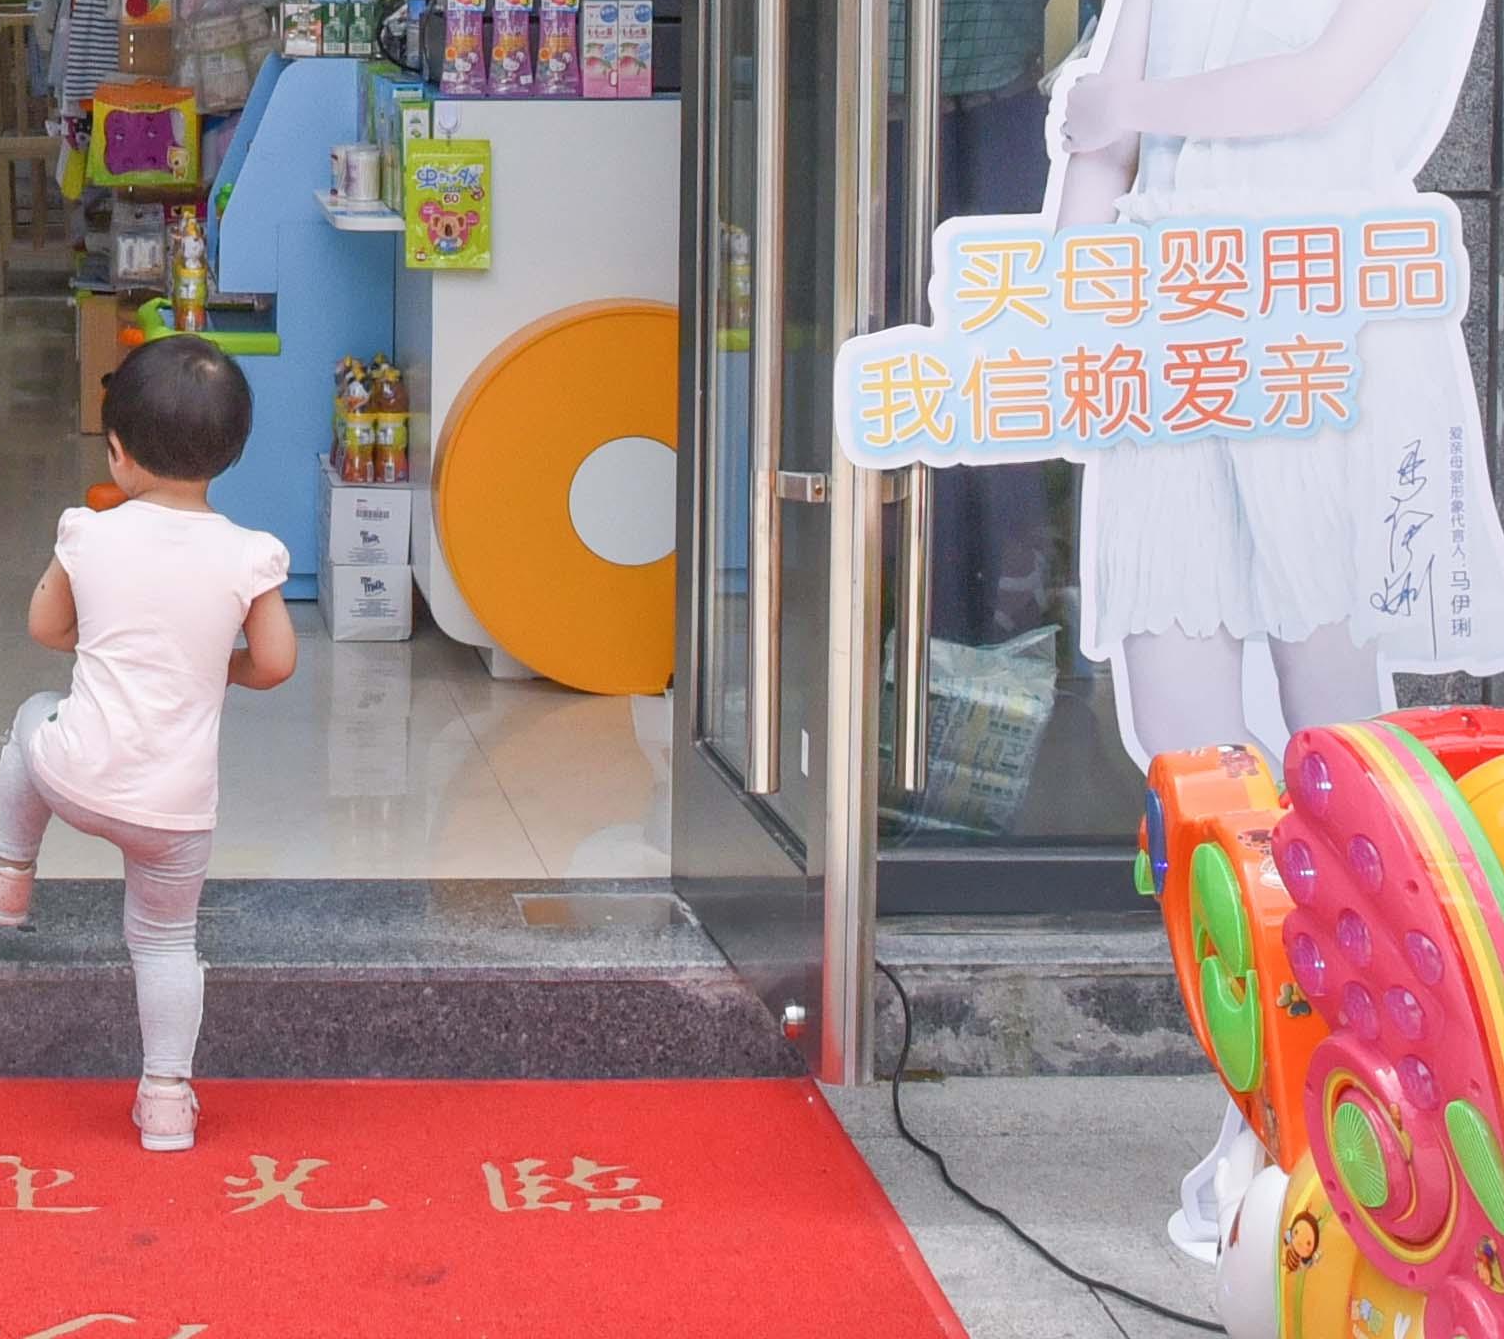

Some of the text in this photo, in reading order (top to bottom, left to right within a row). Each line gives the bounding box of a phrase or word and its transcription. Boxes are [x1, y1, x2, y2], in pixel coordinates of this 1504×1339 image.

[953, 219, 1447, 332] 买母婴用品
[858, 334, 1351, 447] 我信赖爱亲
